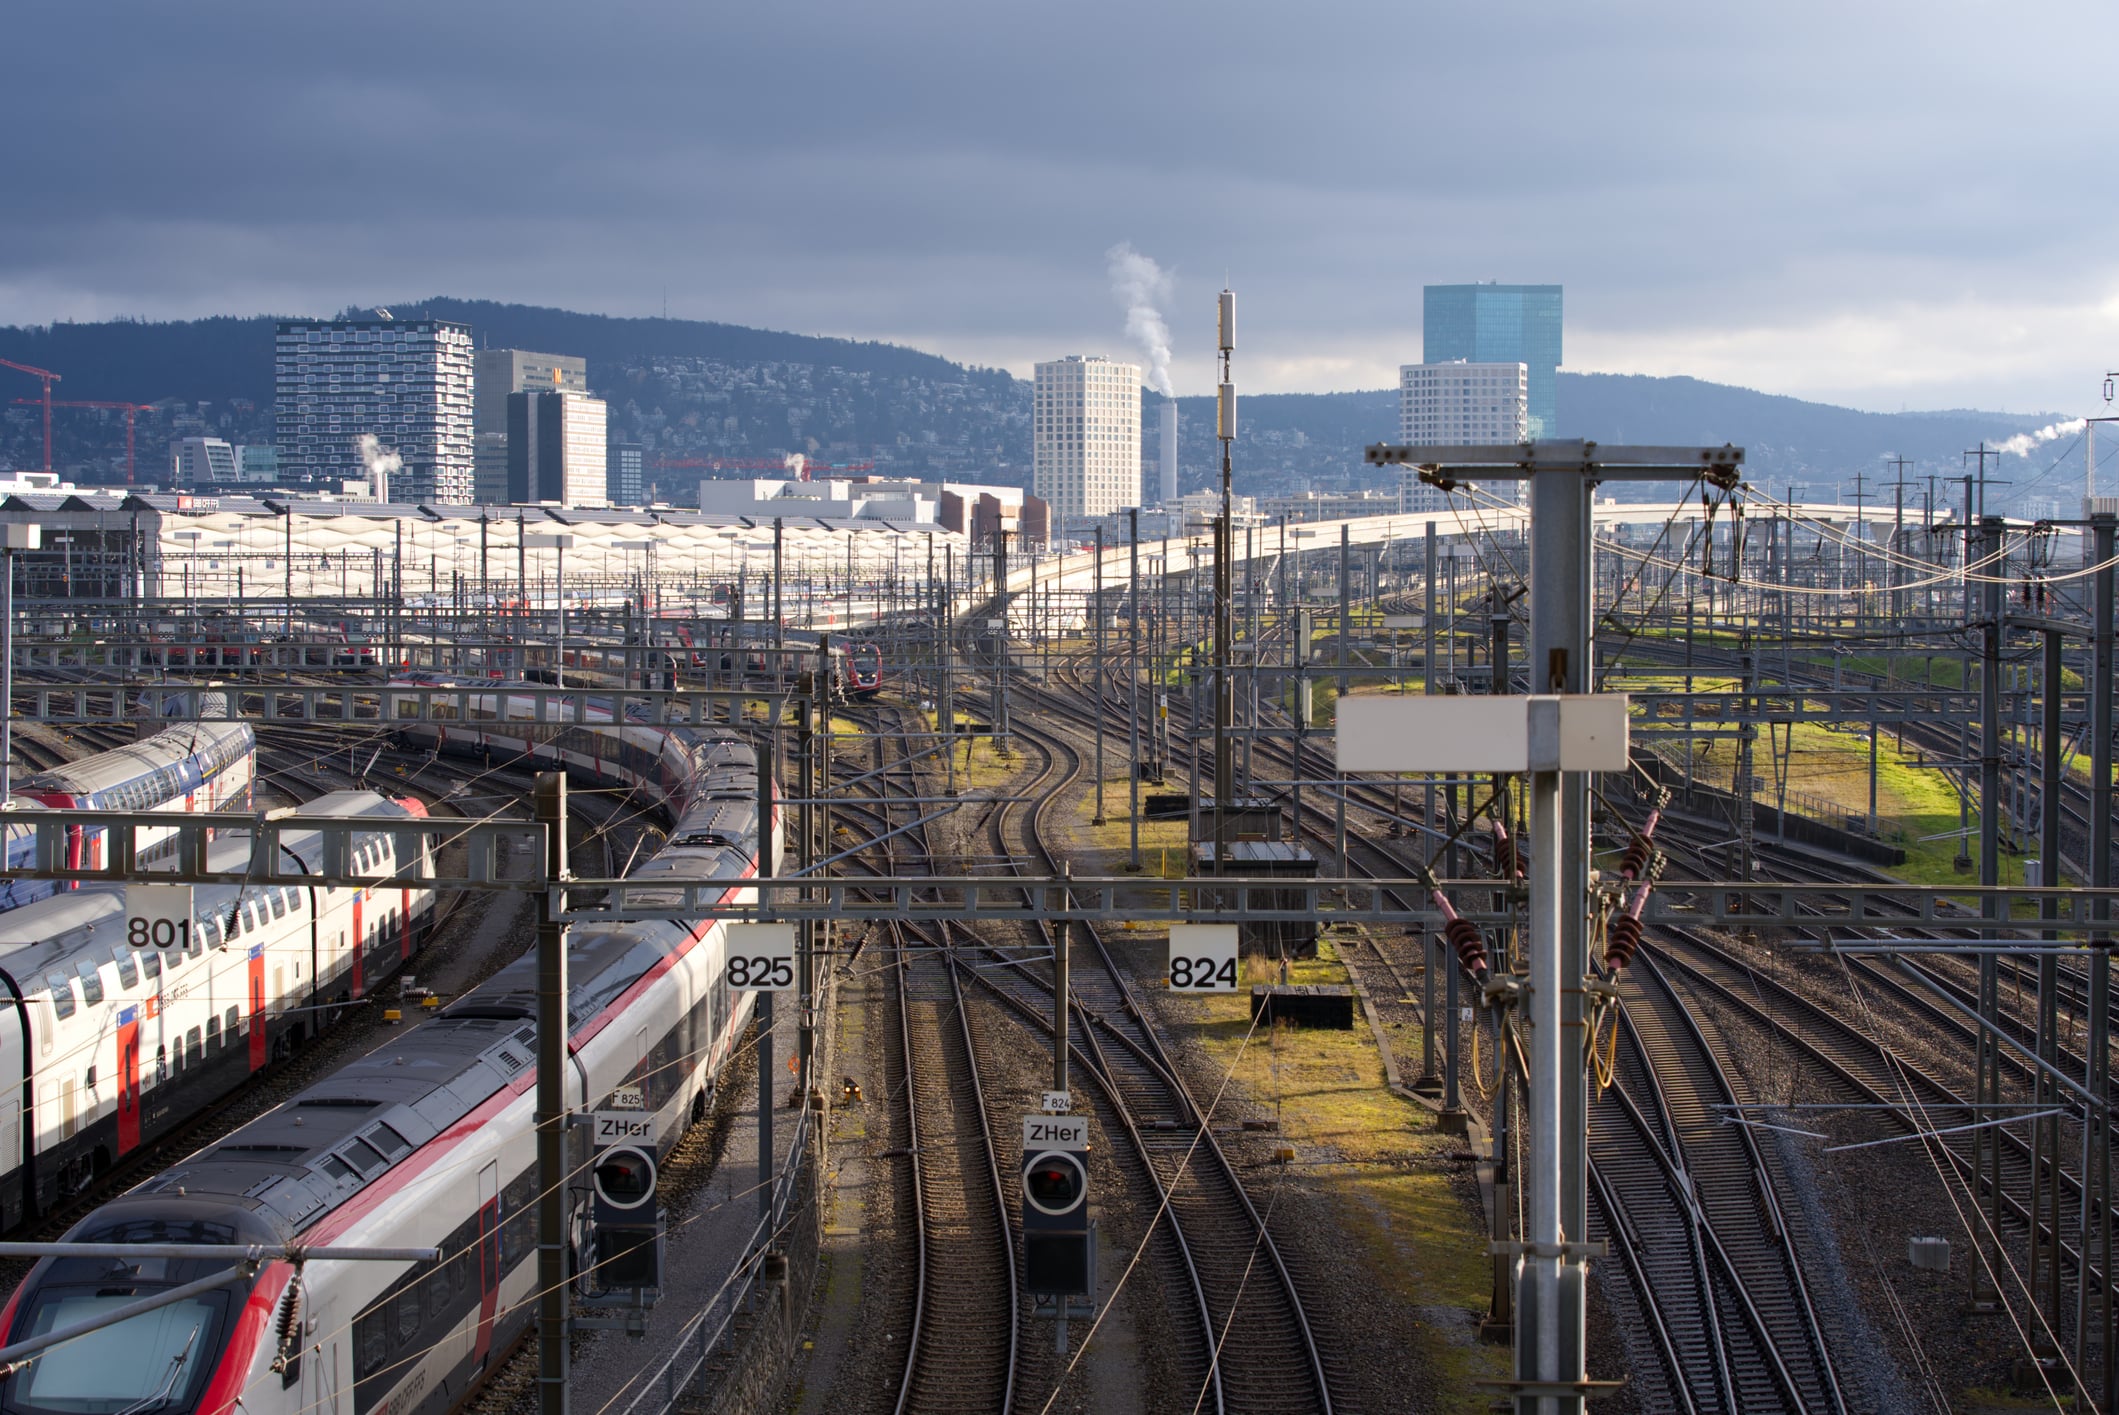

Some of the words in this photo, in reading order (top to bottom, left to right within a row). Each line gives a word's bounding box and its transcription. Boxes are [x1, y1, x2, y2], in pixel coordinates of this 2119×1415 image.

[127, 917, 189, 948] 801
[727, 955, 794, 987] 825
[1170, 956, 1238, 988] 824
[612, 1089, 620, 1104] F
[621, 1094, 640, 1105] 825
[1041, 1093, 1050, 1108] F
[1051, 1098, 1070, 1109] 824
[601, 1120, 651, 1137] ZHer
[1030, 1124, 1081, 1141] ZHer
